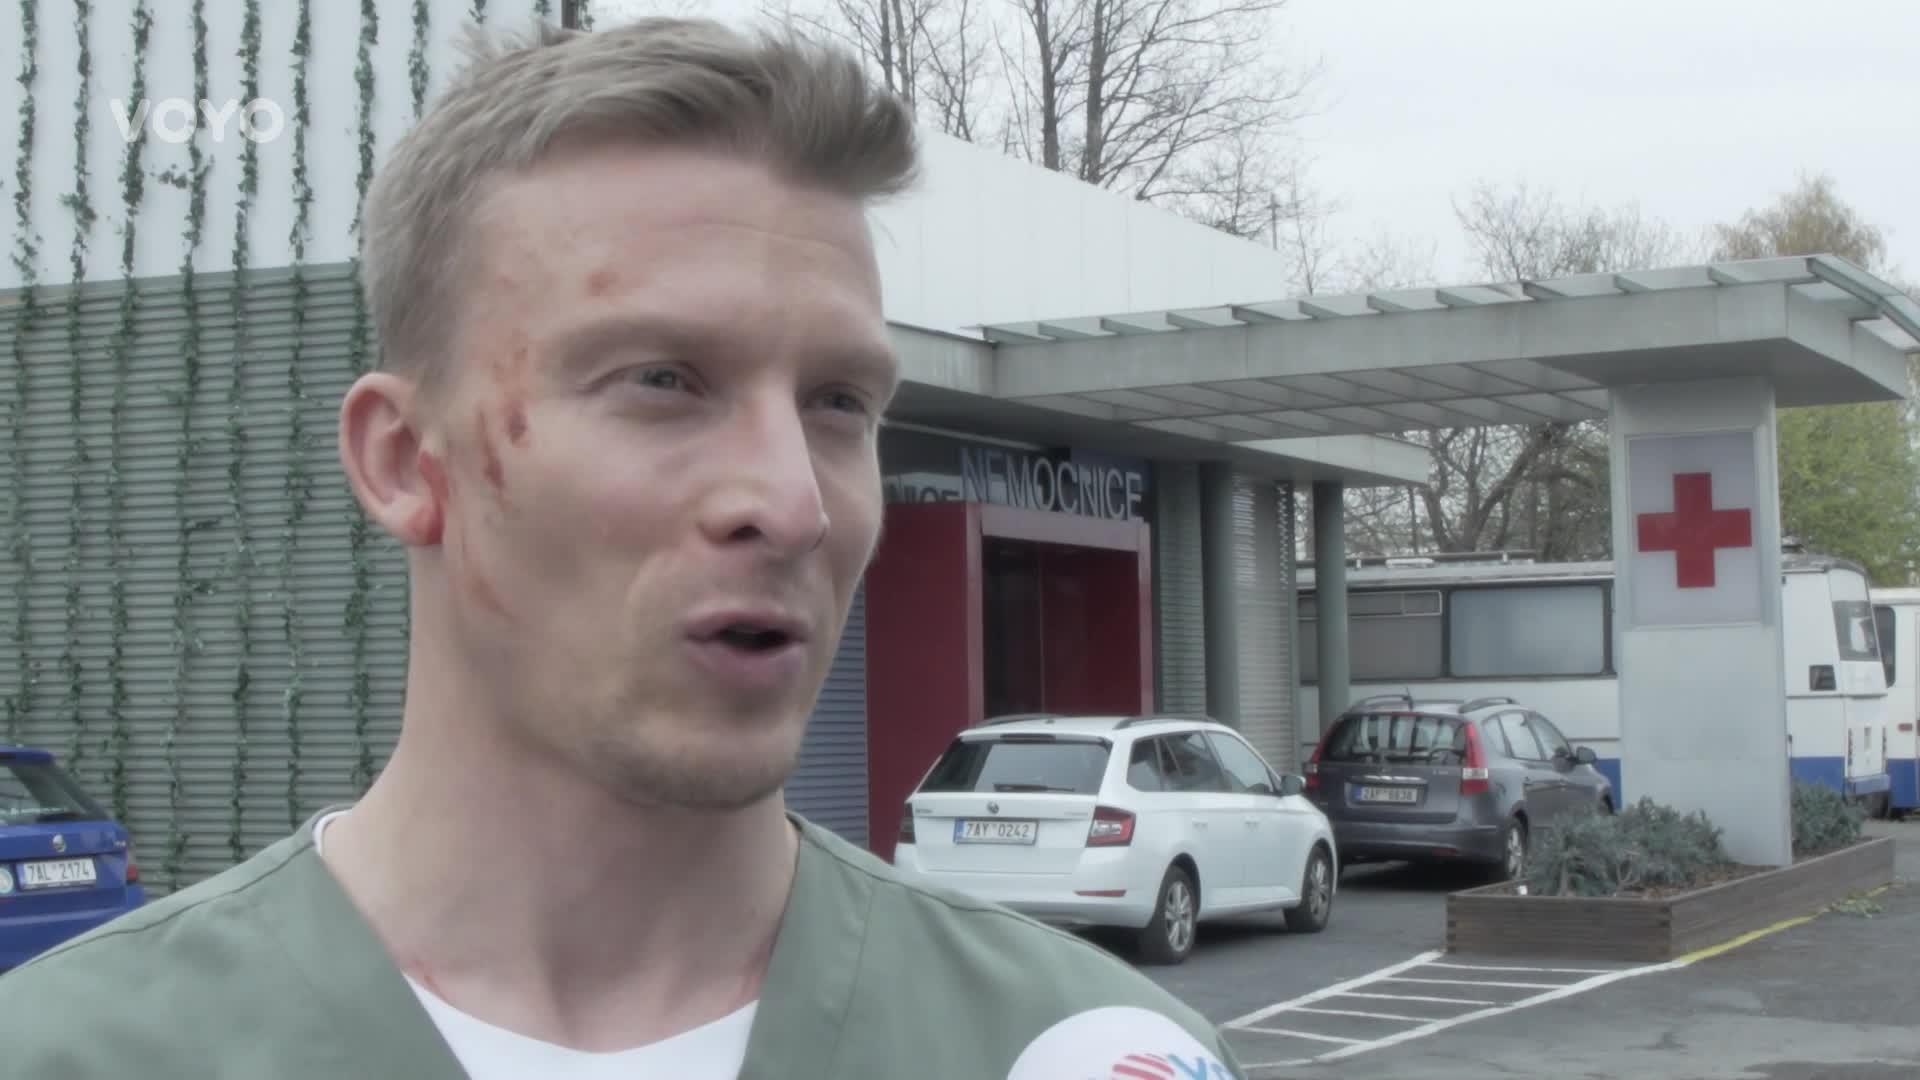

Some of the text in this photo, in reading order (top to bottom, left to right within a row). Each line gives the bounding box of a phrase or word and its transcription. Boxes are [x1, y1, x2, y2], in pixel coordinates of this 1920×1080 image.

[960, 448, 1143, 522] NEMOCNICE
[965, 822, 1030, 838] 7AY 0242
[27, 862, 91, 881] 7AL 2174
